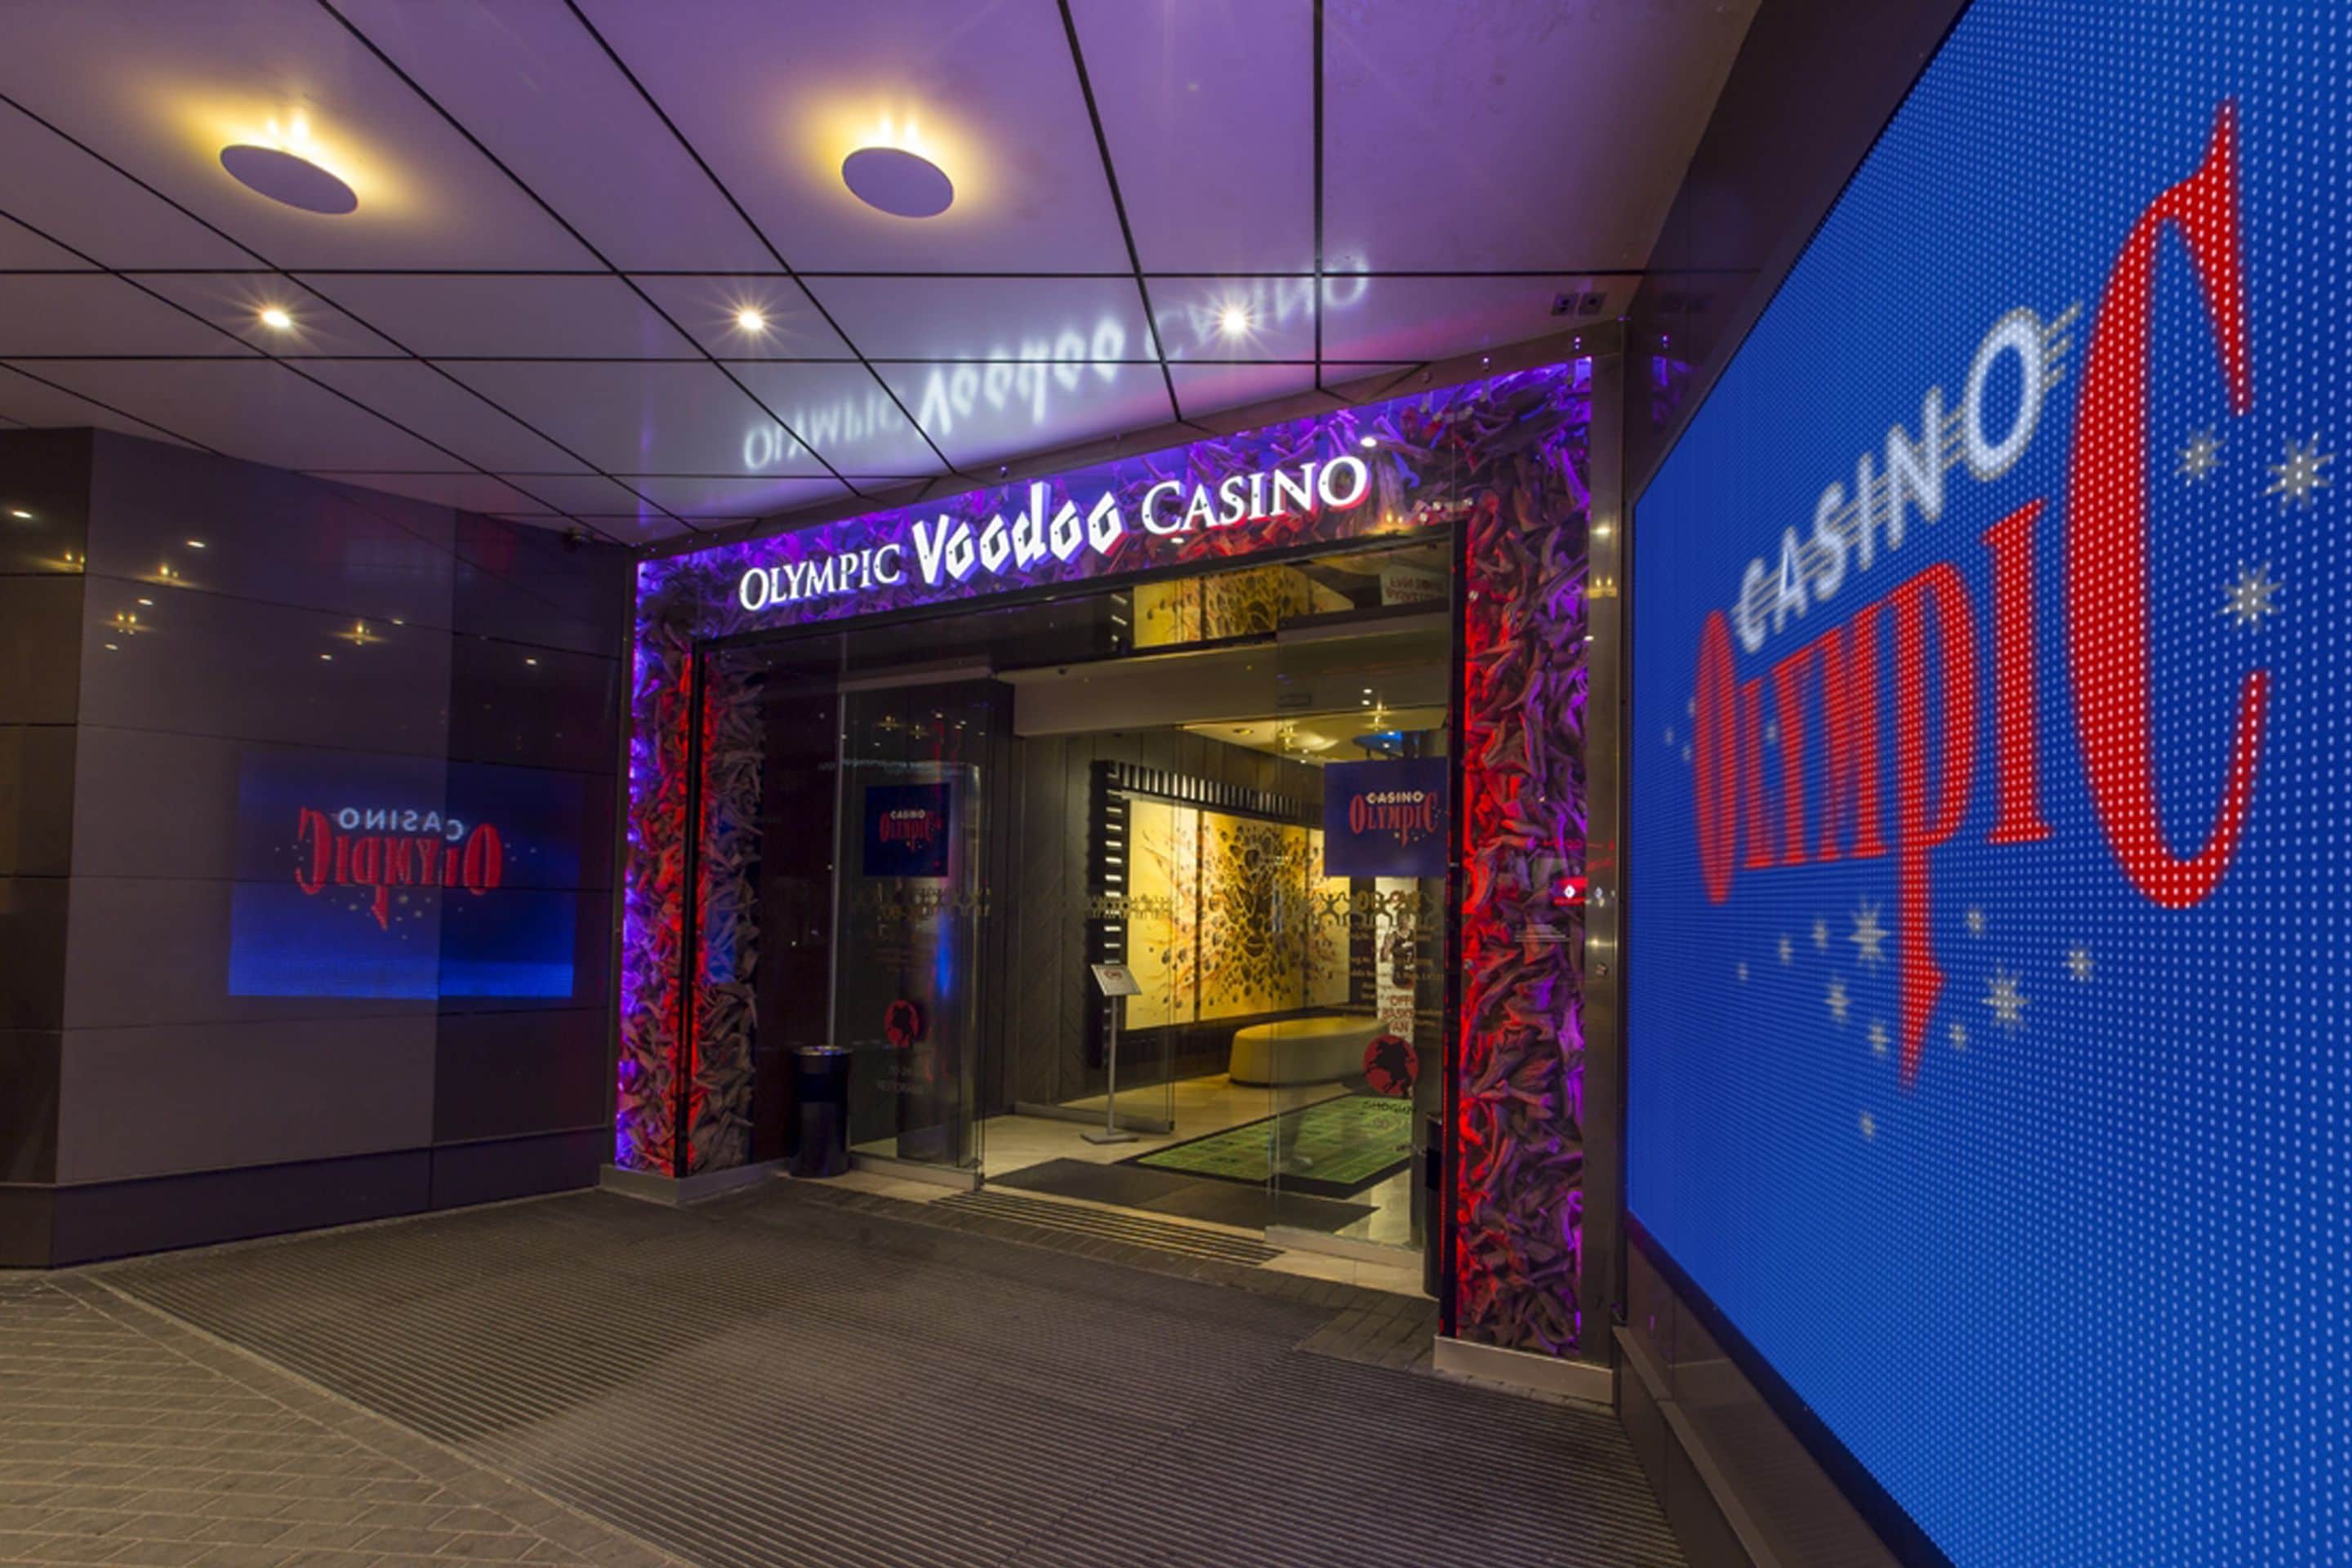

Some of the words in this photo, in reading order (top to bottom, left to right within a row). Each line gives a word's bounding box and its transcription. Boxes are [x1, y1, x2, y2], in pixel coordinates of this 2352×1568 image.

[738, 544, 902, 612] OLYMPIC
[911, 481, 1127, 586] Voodoo
[1141, 454, 1370, 537] CASINO
[1735, 306, 2048, 653] CASINO
[1693, 97, 2269, 1094] OLYMPIC
[1349, 791, 1438, 848] OLYMPIC
[1365, 791, 1424, 804] CASINO
